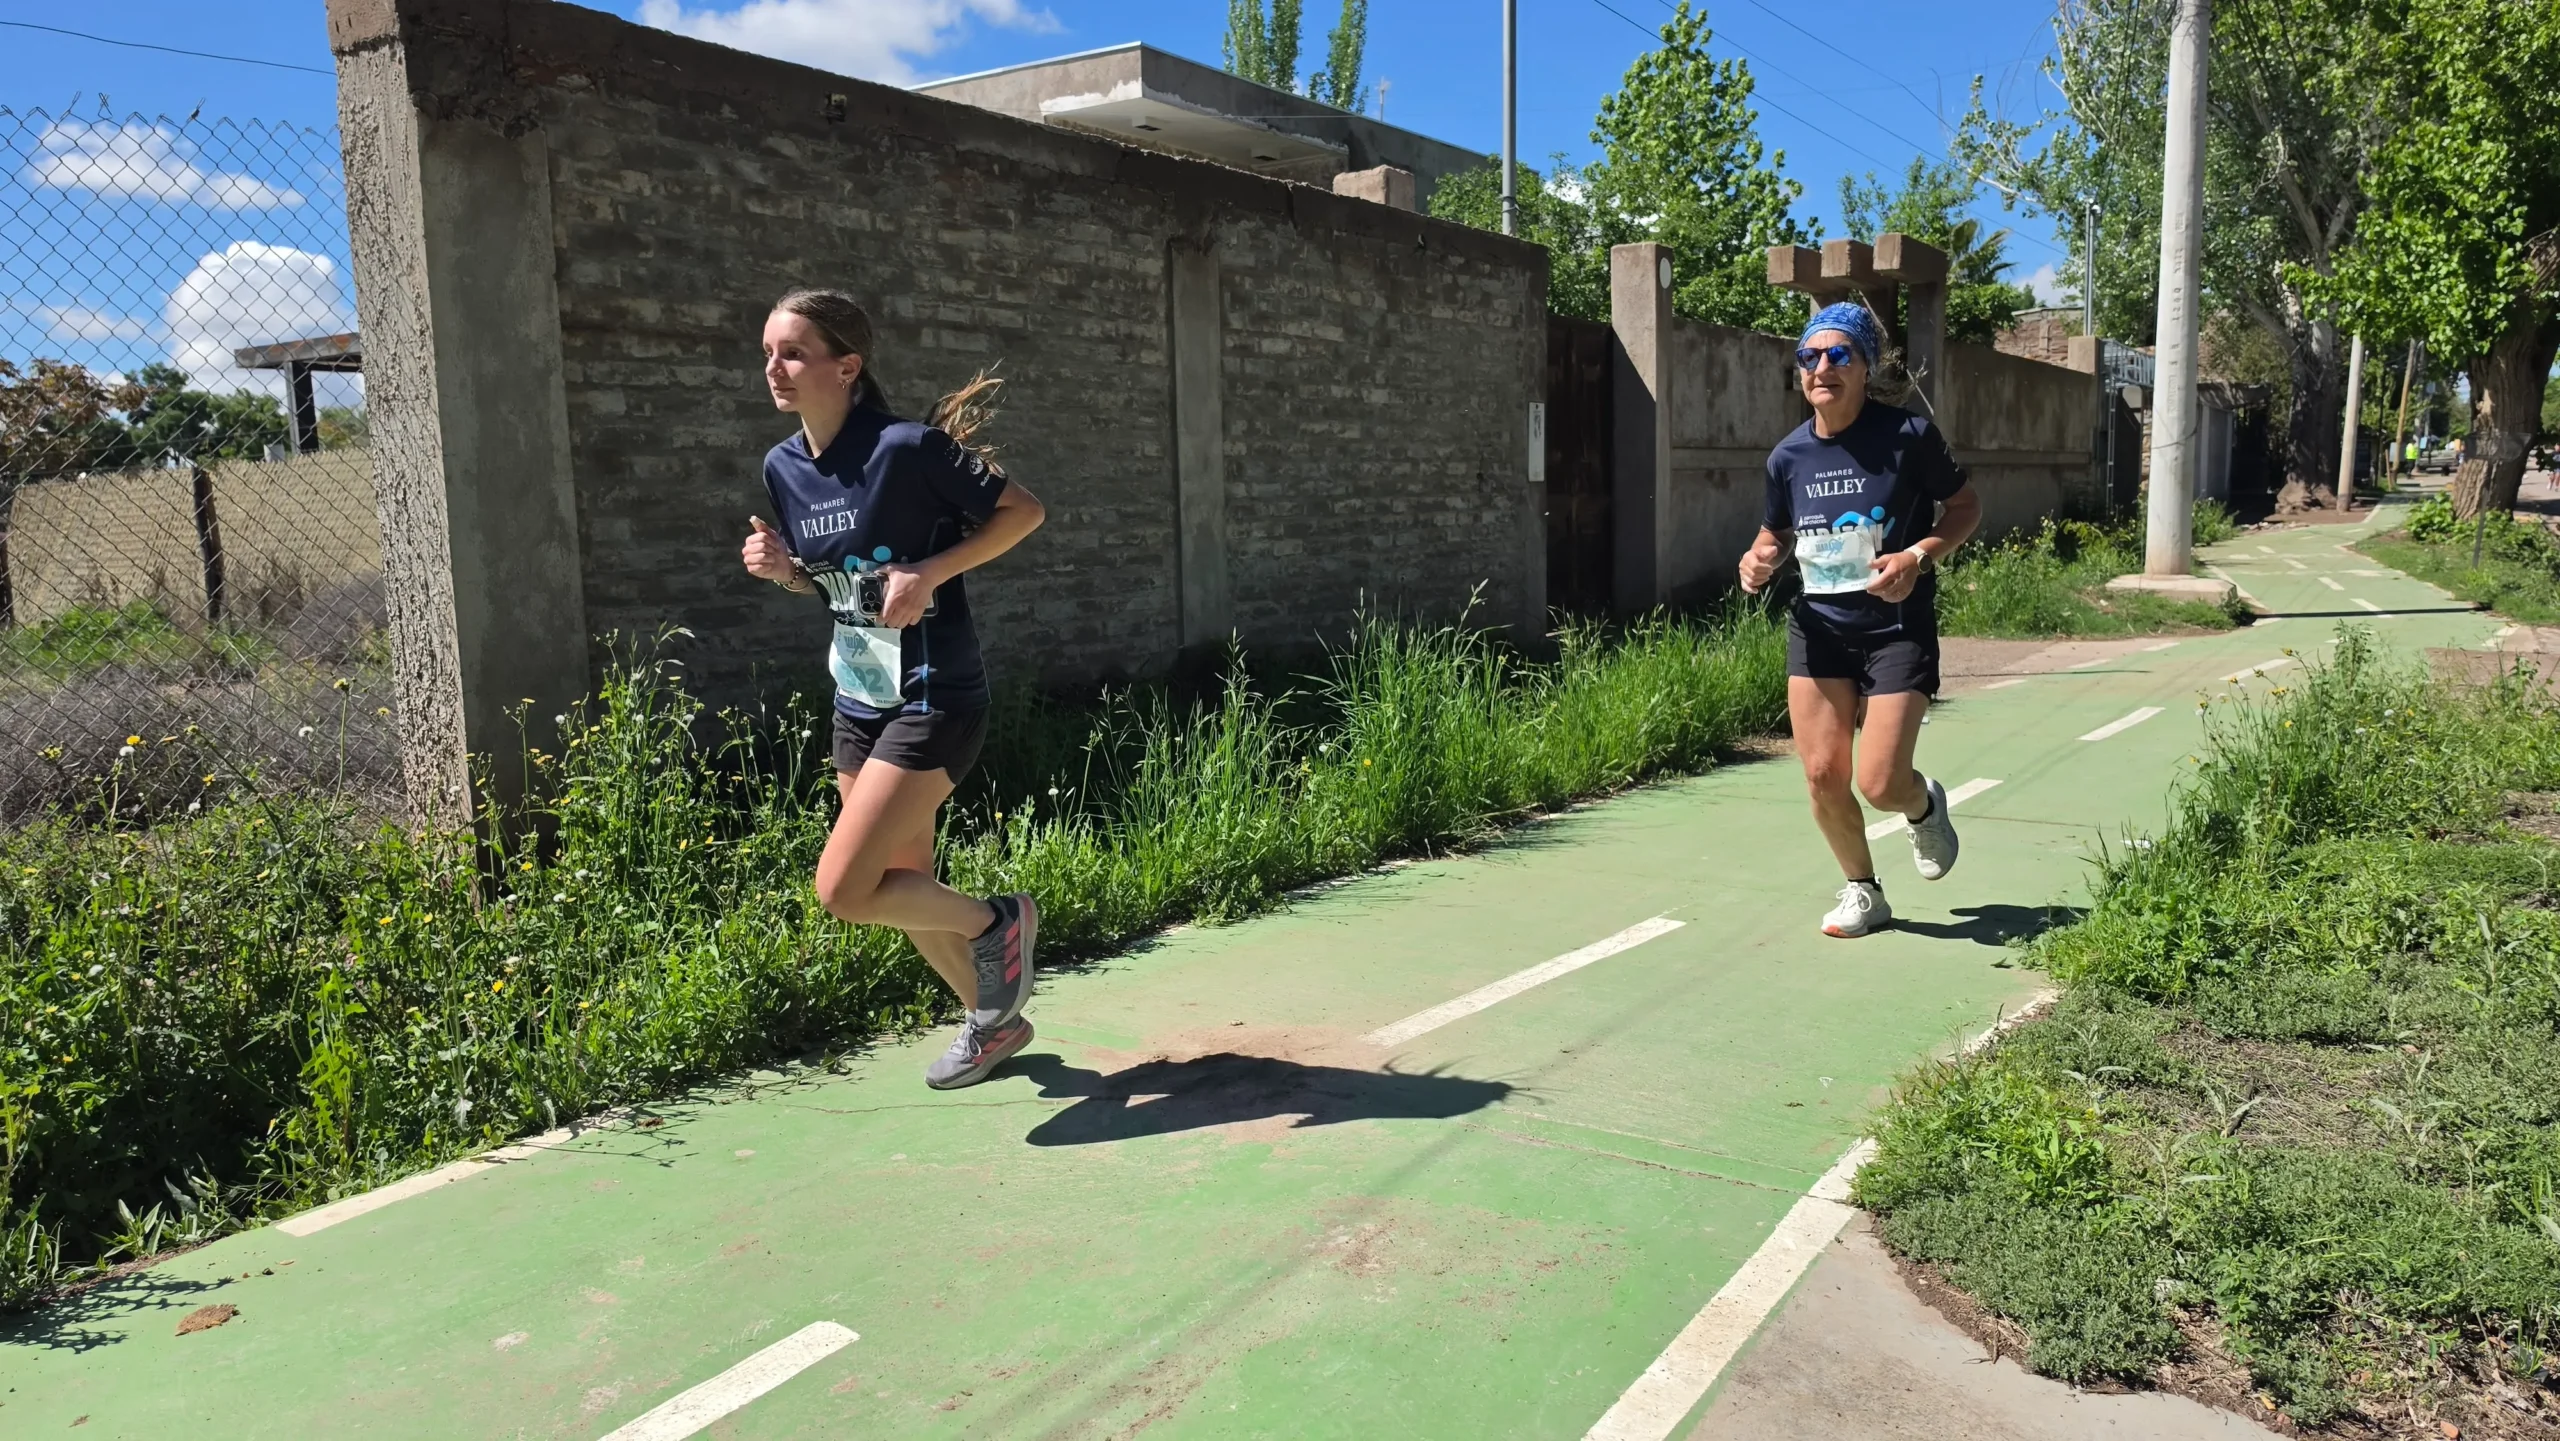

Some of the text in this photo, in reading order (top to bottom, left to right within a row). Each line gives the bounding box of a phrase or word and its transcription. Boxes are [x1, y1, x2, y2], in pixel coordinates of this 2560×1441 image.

[1815, 468, 1853, 479] PALMARES
[1805, 478, 1867, 499] VALLEY
[810, 497, 845, 512] PALMARES
[800, 509, 859, 539] VALLEY
